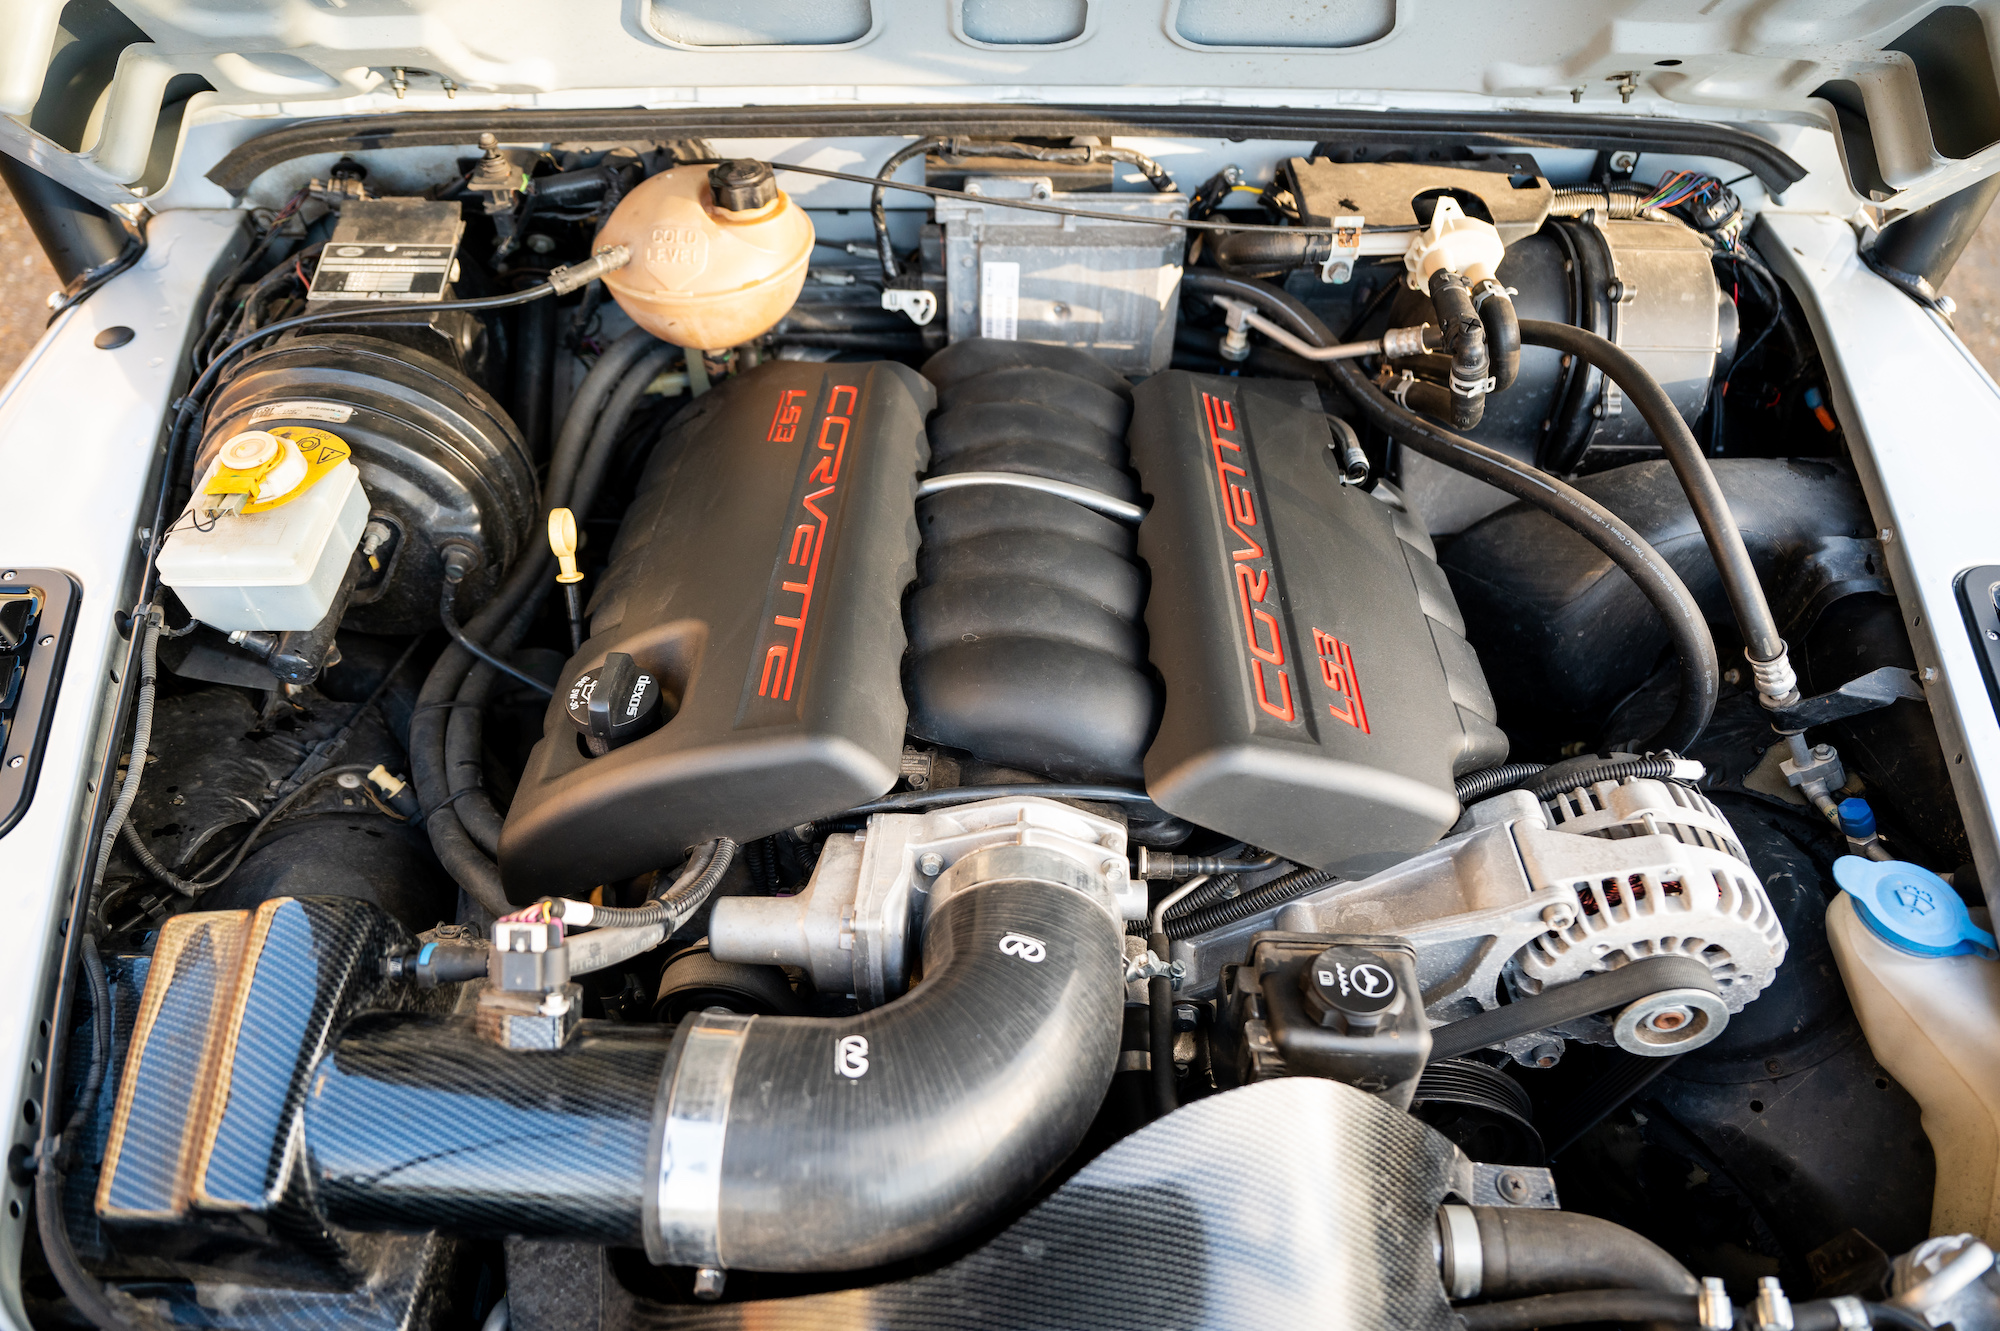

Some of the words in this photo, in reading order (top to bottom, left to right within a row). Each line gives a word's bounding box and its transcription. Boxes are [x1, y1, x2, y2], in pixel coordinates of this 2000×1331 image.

[652, 229, 698, 245] COLD
[646, 247, 698, 265] LEVEL
[767, 389, 808, 443] LS3
[757, 384, 858, 701] CORVETTE
[1610, 526, 1626, 541] Class
[1202, 391, 1296, 722] CORVETTE
[1631, 544, 1645, 559] Type
[1647, 560, 1674, 592] Refrigerant
[1672, 590, 1692, 618] Premium
[574, 675, 591, 688] SAE
[1312, 626, 1370, 734] LS3
[569, 688, 580, 711] 5W-30
[626, 675, 651, 718] dexos
